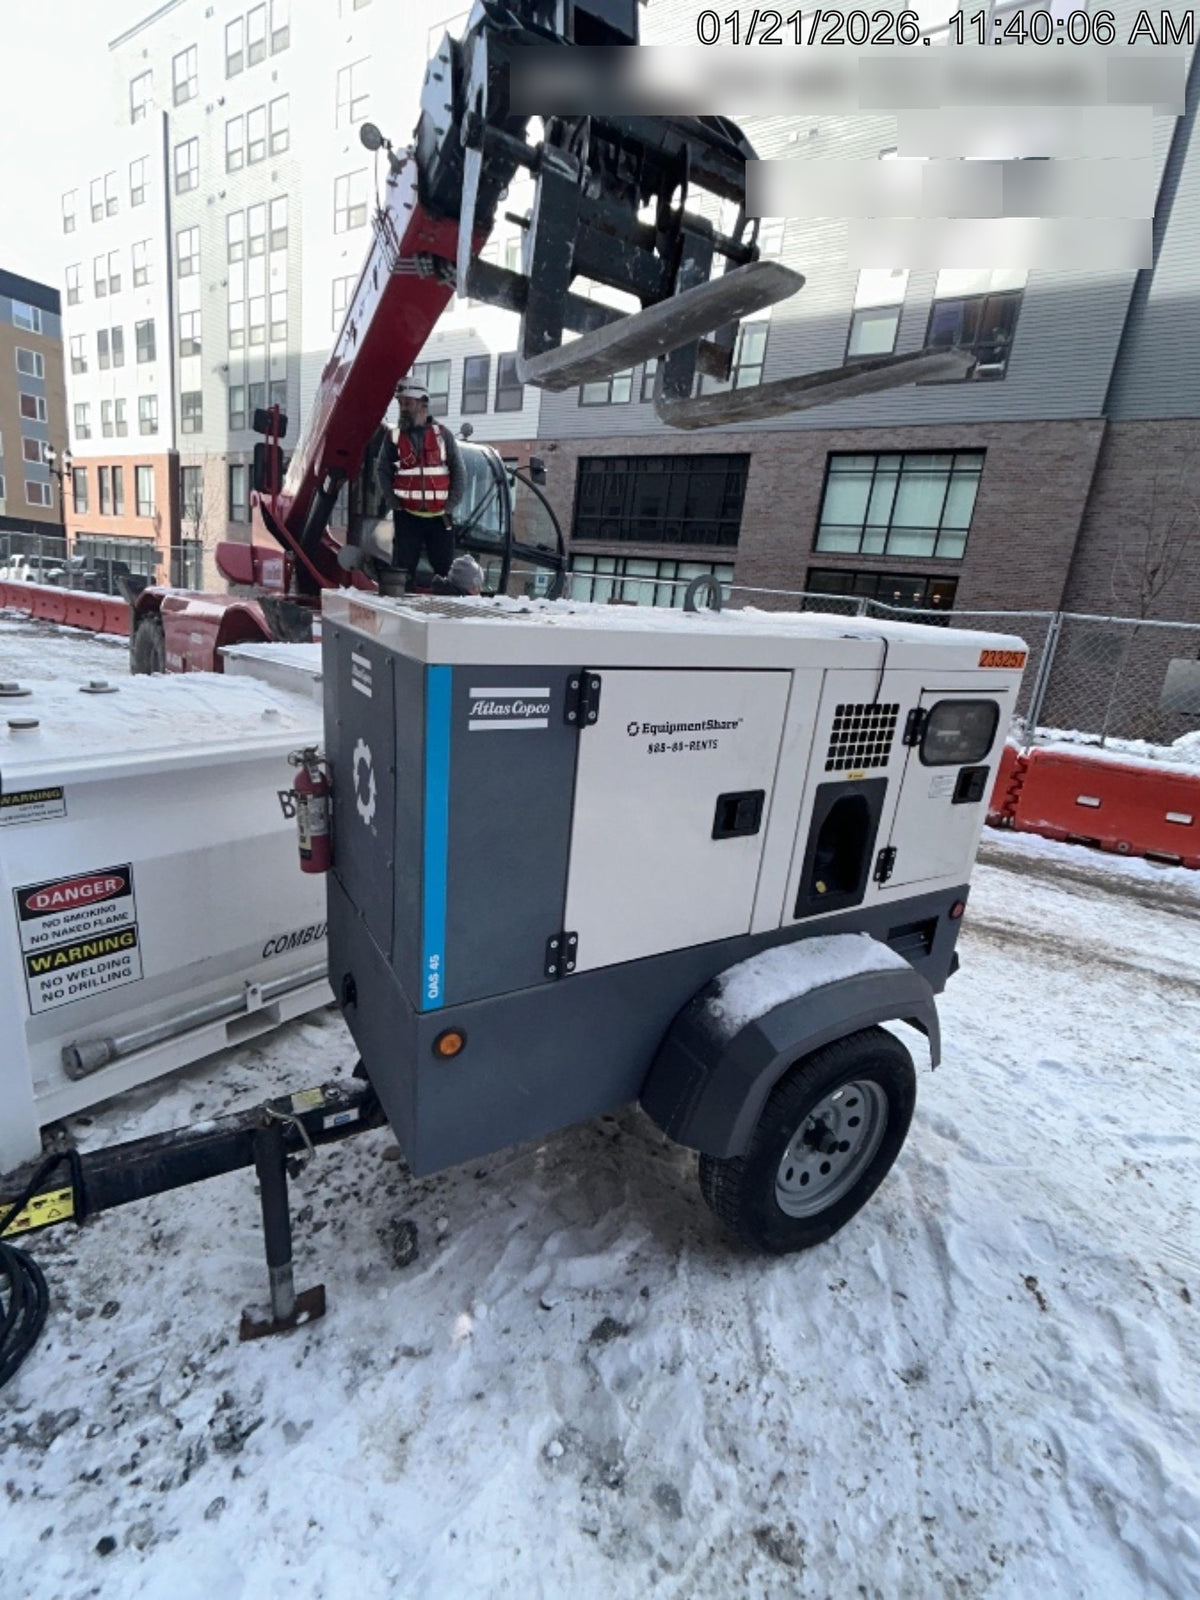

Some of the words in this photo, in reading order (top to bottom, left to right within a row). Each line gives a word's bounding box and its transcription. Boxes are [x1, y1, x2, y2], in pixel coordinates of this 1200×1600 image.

[978, 650, 1026, 668] 233257
[468, 700, 510, 716] Atlas
[512, 700, 551, 717] Copco
[36, 879, 117, 908] DANGER
[30, 932, 49, 944] NO
[52, 922, 91, 939] NAKED
[93, 912, 129, 928] FLAME
[42, 917, 61, 929] NO
[63, 904, 117, 923] SMOKING
[30, 932, 134, 972] WARNING
[262, 922, 328, 958] COMBU
[40, 976, 63, 990] NO
[66, 955, 131, 982] WELDING
[429, 954, 440, 970] 45
[41, 989, 65, 1003] NO
[68, 968, 132, 995] DRILLING
